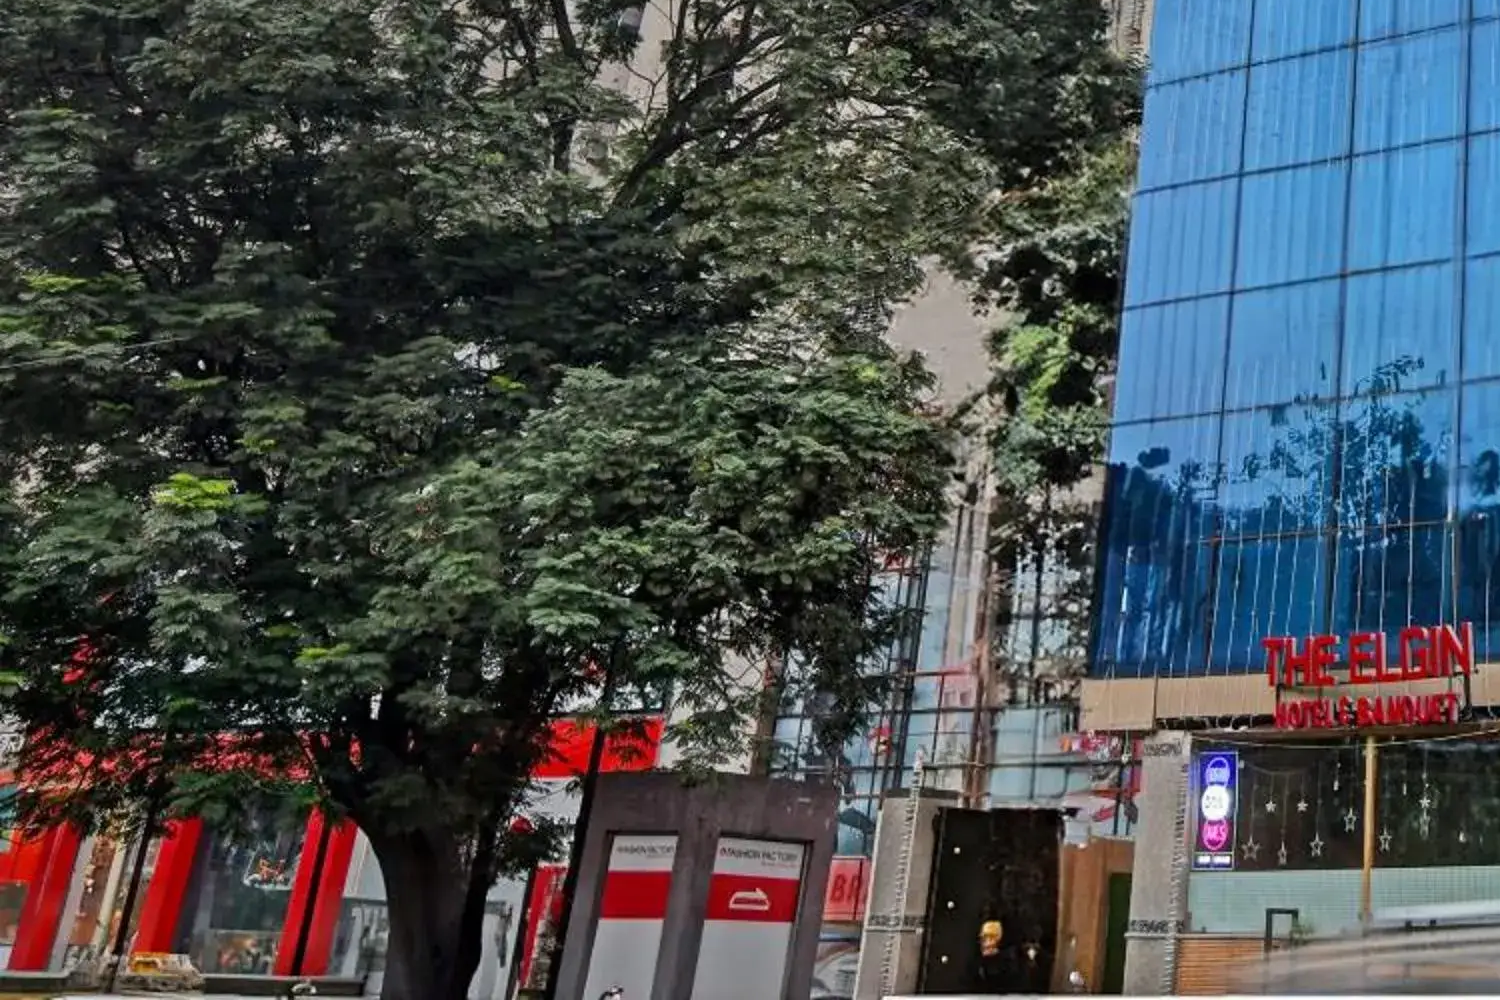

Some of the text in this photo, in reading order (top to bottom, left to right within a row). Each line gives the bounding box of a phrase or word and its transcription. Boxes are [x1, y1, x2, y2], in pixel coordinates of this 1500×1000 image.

[1262, 621, 1473, 688] THE ELGIN
[1356, 692, 1460, 728] BANQUET
